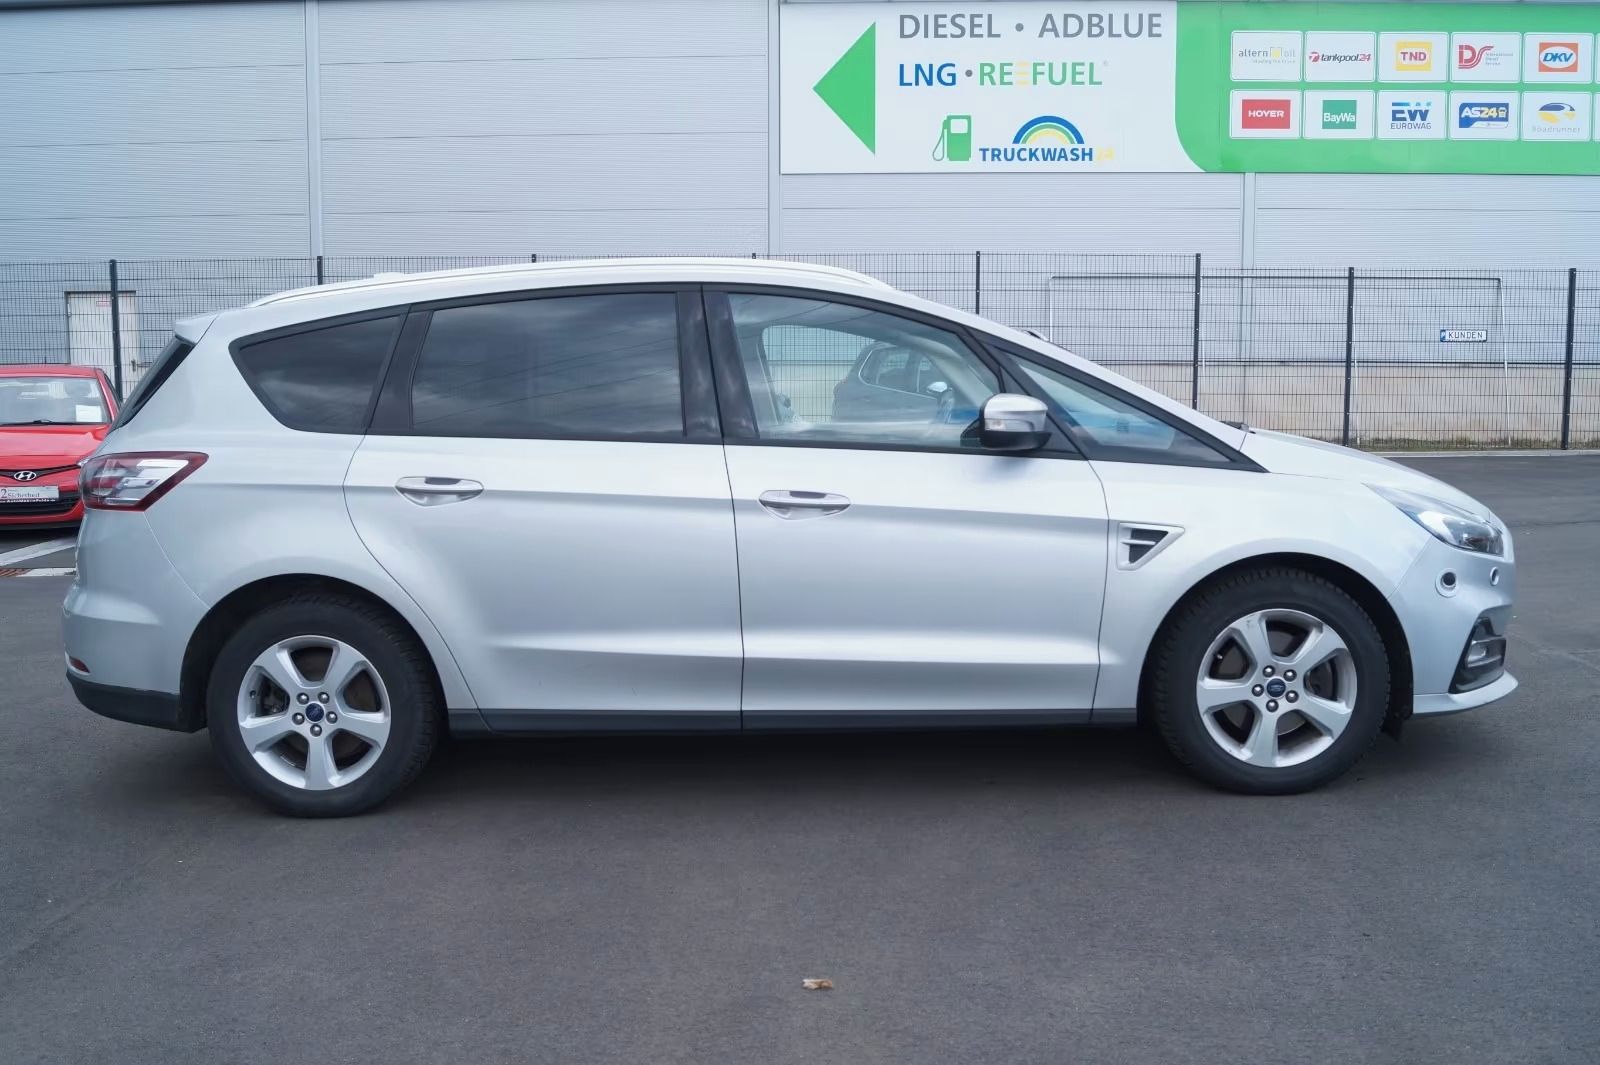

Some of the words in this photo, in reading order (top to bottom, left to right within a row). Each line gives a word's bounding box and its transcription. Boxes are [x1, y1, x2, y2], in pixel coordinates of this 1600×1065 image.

[899, 13, 1001, 39] DIESEL
[1038, 13, 1162, 38] ADBLUE
[1400, 51, 1427, 61] TND
[1543, 52, 1574, 62] DKV
[899, 63, 957, 87] LNG
[1323, 112, 1356, 124] BayWa
[1461, 106, 1498, 118] AS24
[1391, 122, 1432, 130] EUROWAG
[979, 147, 1094, 162] TRUCKWASH
[1448, 331, 1483, 339] KUNDEN
